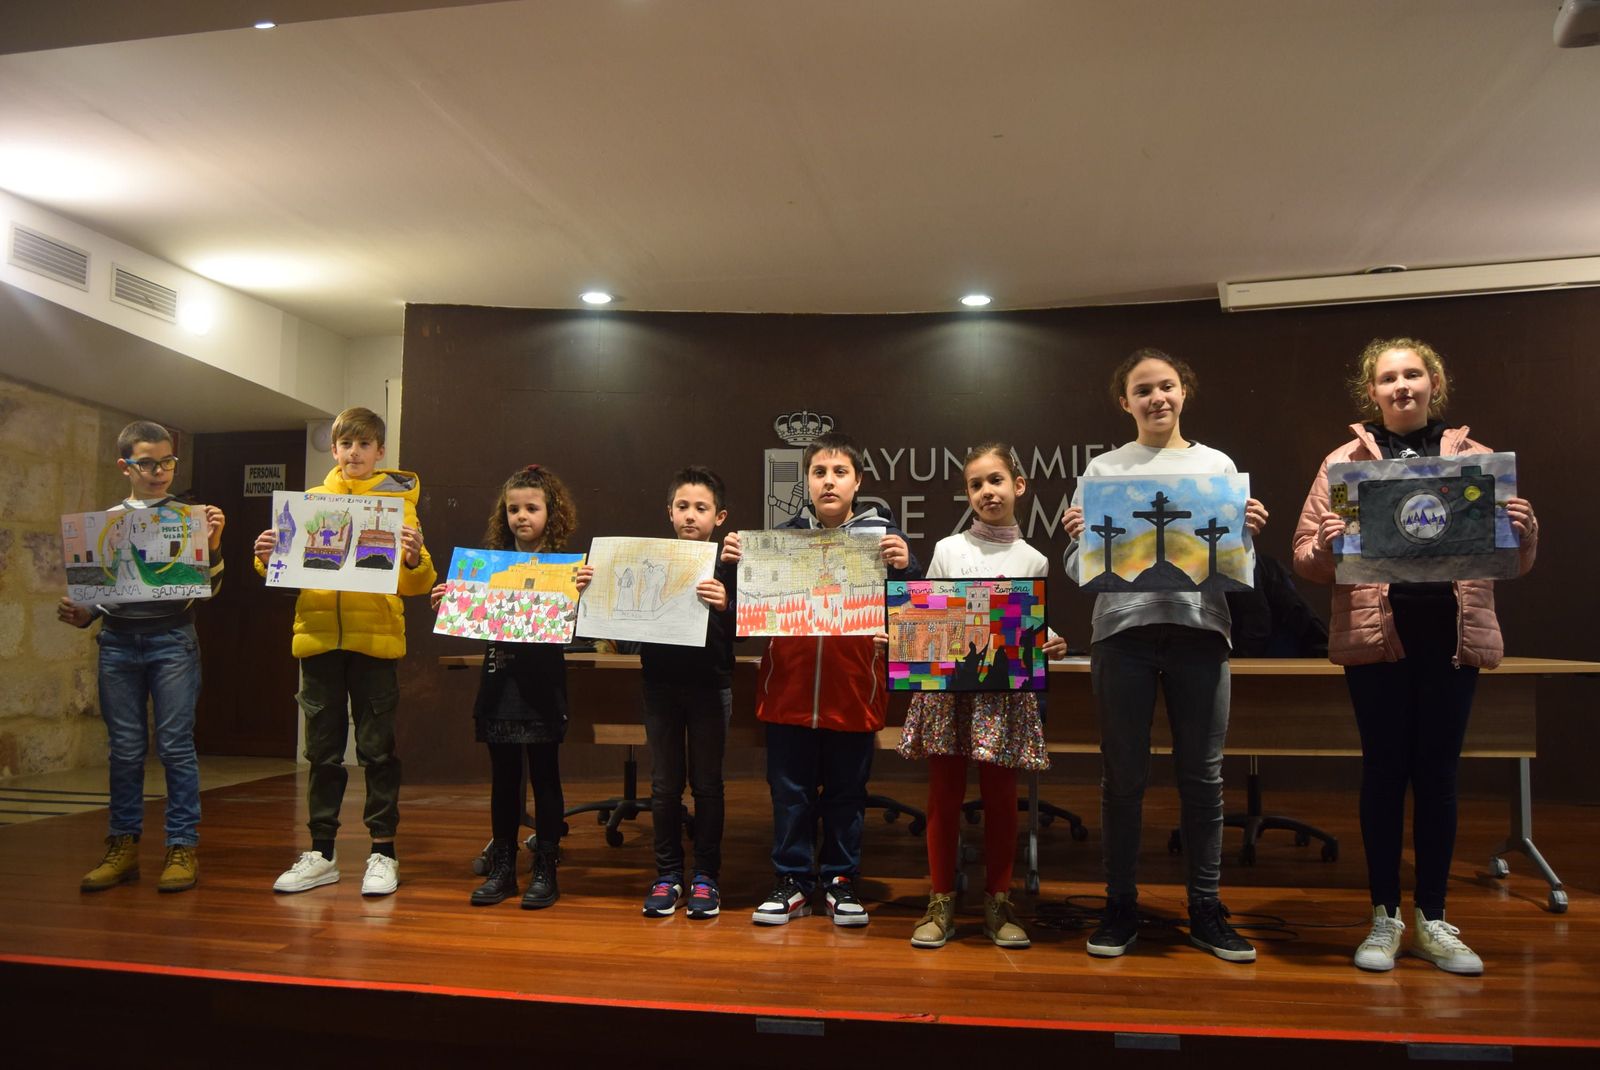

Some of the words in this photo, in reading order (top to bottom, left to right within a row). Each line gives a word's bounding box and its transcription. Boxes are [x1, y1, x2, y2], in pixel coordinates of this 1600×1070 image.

[249, 466, 280, 479] PERSONAL
[73, 585, 142, 600] SEMANA
[152, 585, 202, 599] SANTA
